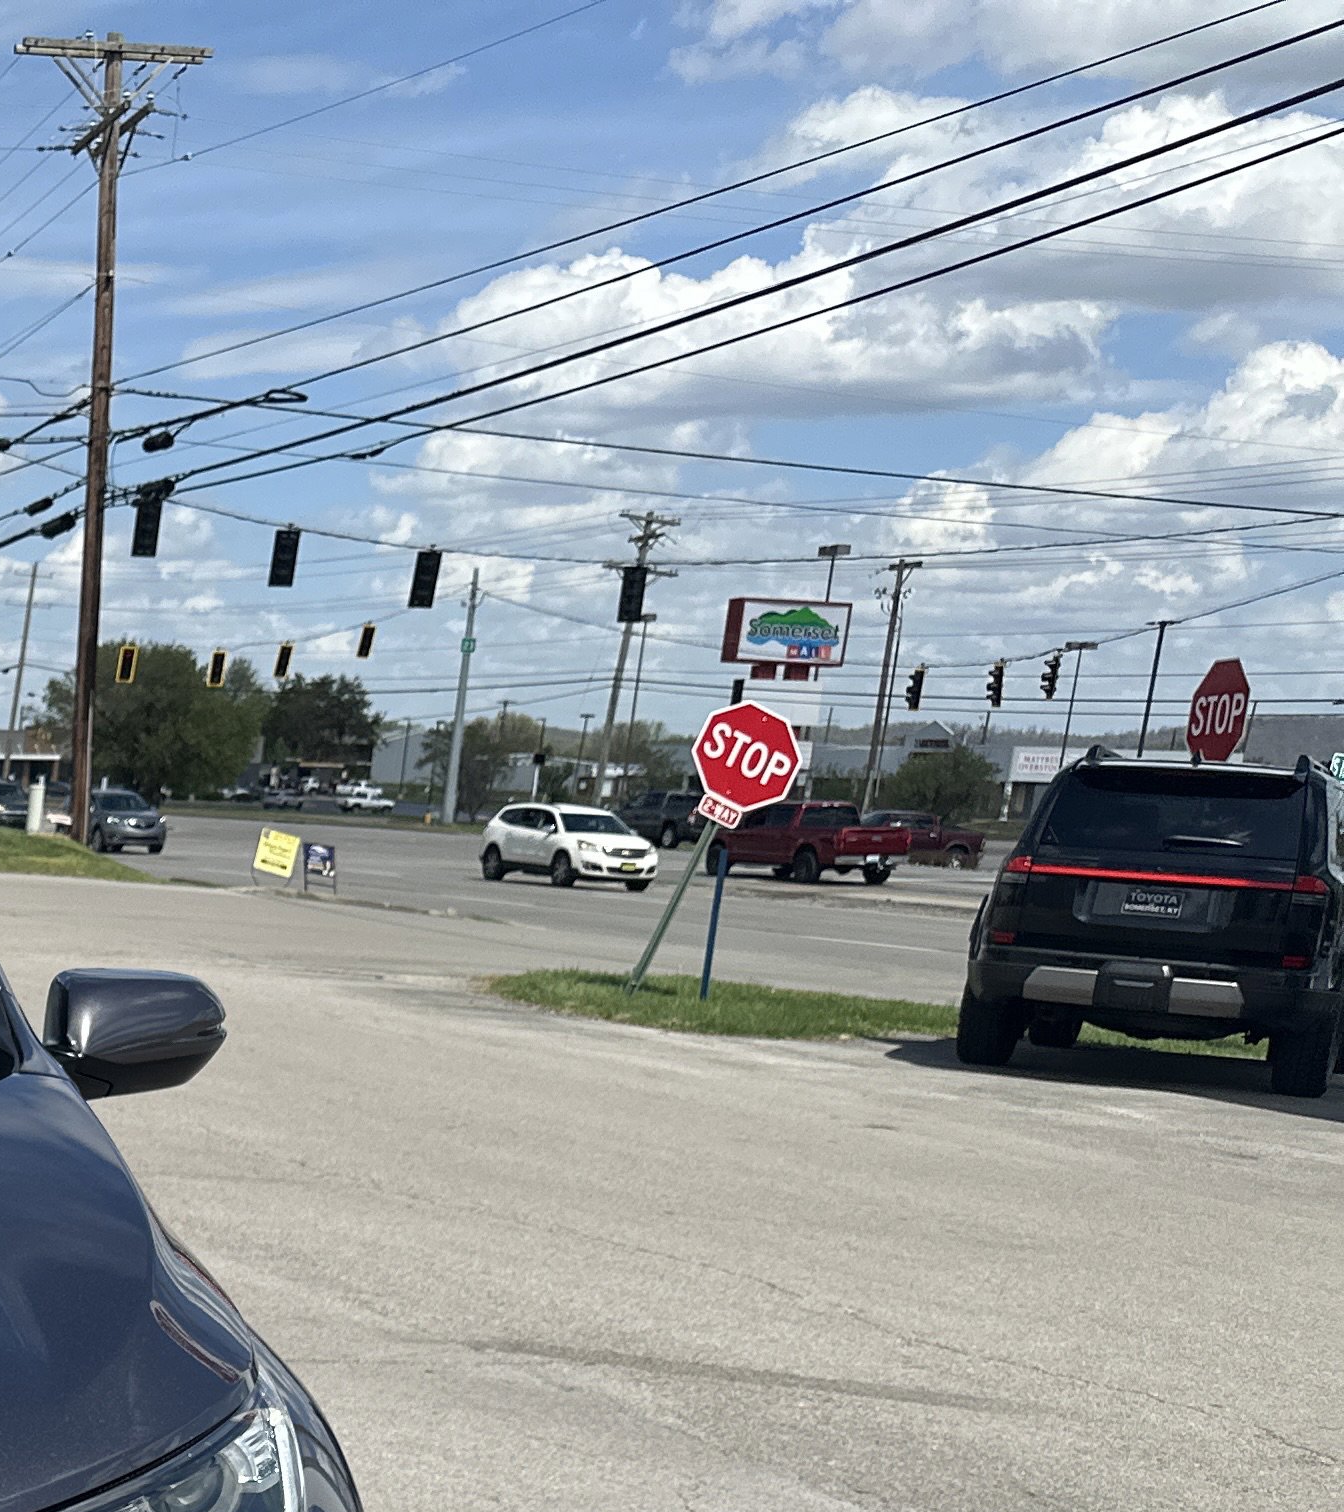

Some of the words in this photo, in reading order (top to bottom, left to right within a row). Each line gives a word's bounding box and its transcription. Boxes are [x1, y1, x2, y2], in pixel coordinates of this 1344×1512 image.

[747, 619, 840, 641] Somerset
[1191, 692, 1245, 736] STOP
[703, 721, 791, 785] STOP
[702, 798, 739, 825] 2-WAY
[1130, 892, 1178, 905] TOYOTA
